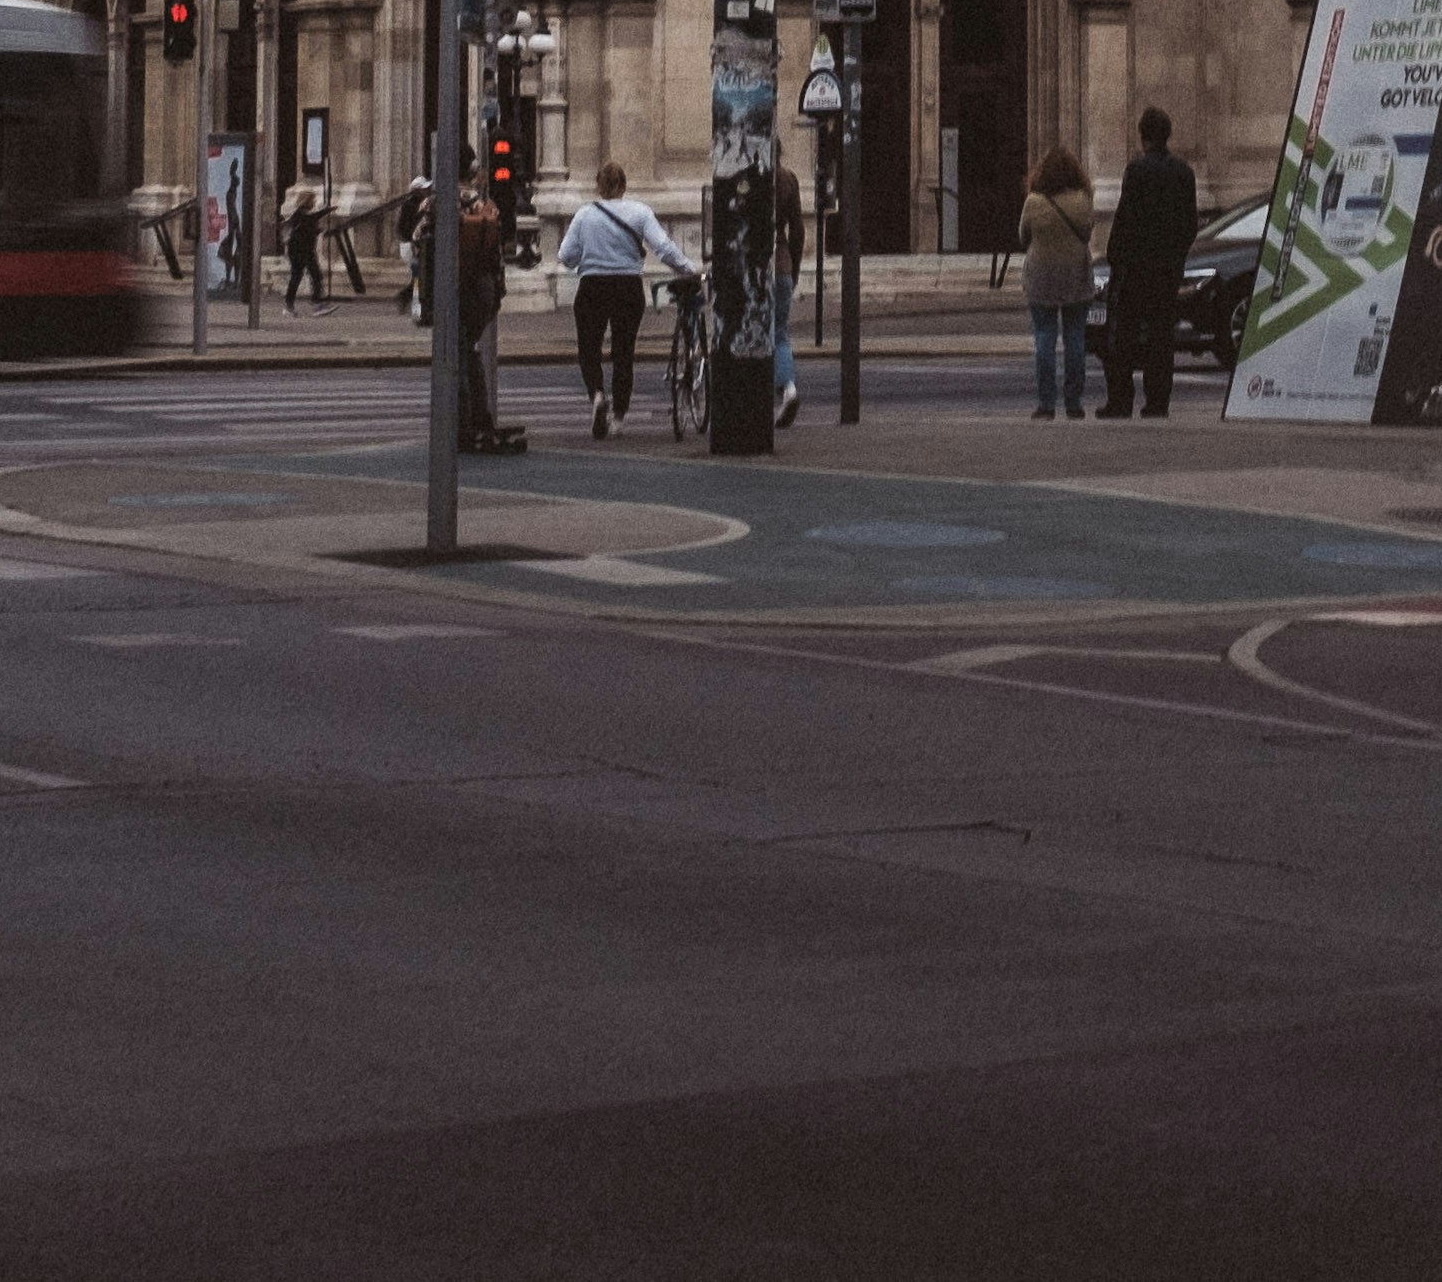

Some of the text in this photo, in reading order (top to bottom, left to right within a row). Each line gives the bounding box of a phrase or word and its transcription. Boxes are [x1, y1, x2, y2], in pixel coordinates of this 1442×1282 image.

[1370, 19, 1421, 41] KOMMT
[1353, 43, 1396, 63] UNTER
[1396, 42, 1418, 62] DIE
[1380, 89, 1411, 109] GOT
